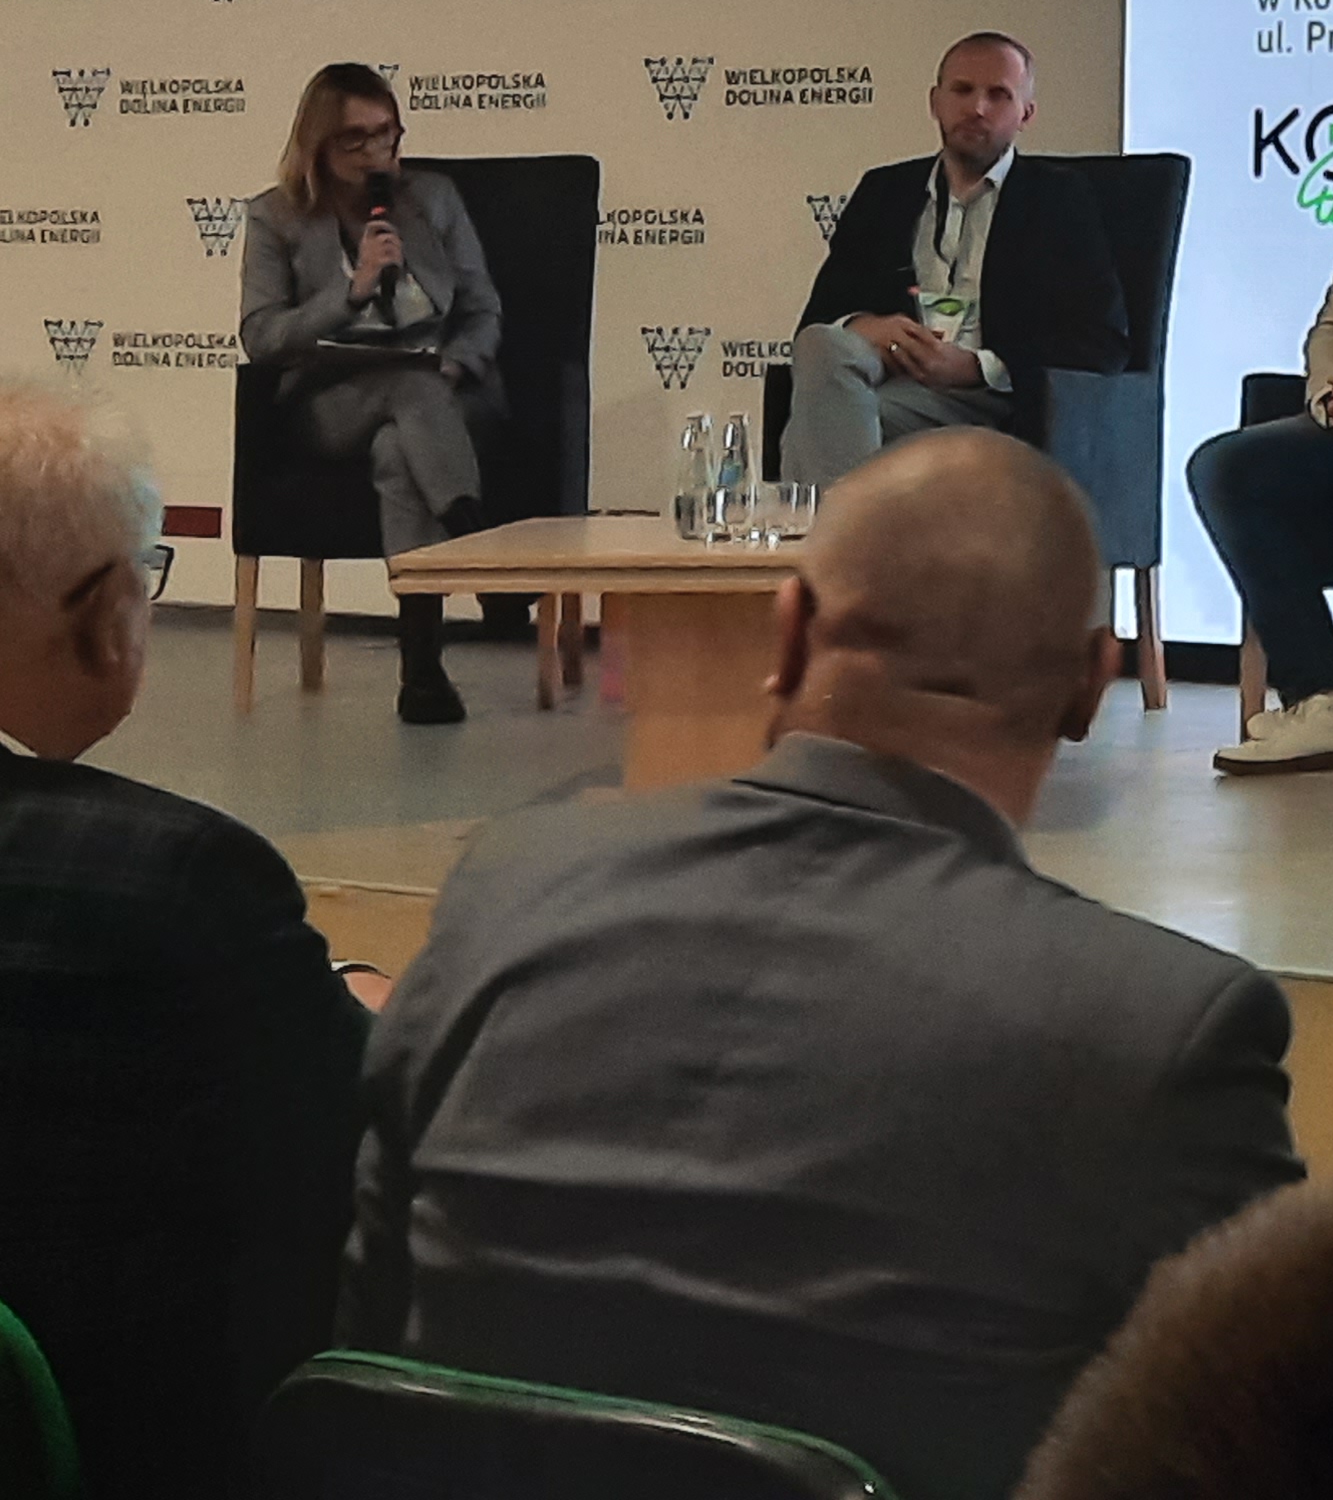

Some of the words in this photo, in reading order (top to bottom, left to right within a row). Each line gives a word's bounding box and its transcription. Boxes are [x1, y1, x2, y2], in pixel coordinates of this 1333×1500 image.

[1257, 20, 1293, 53] ul.
[409, 73, 546, 90] WIELKOPOLSKA
[725, 66, 872, 86] WIELKOPOLSKA
[409, 94, 473, 110] DOLINA
[477, 93, 547, 110] ENERGII
[725, 88, 795, 106] DOLINA
[799, 87, 873, 105] ENERGII
[599, 208, 705, 224] KOPOLSKA
[598, 228, 630, 245] INA
